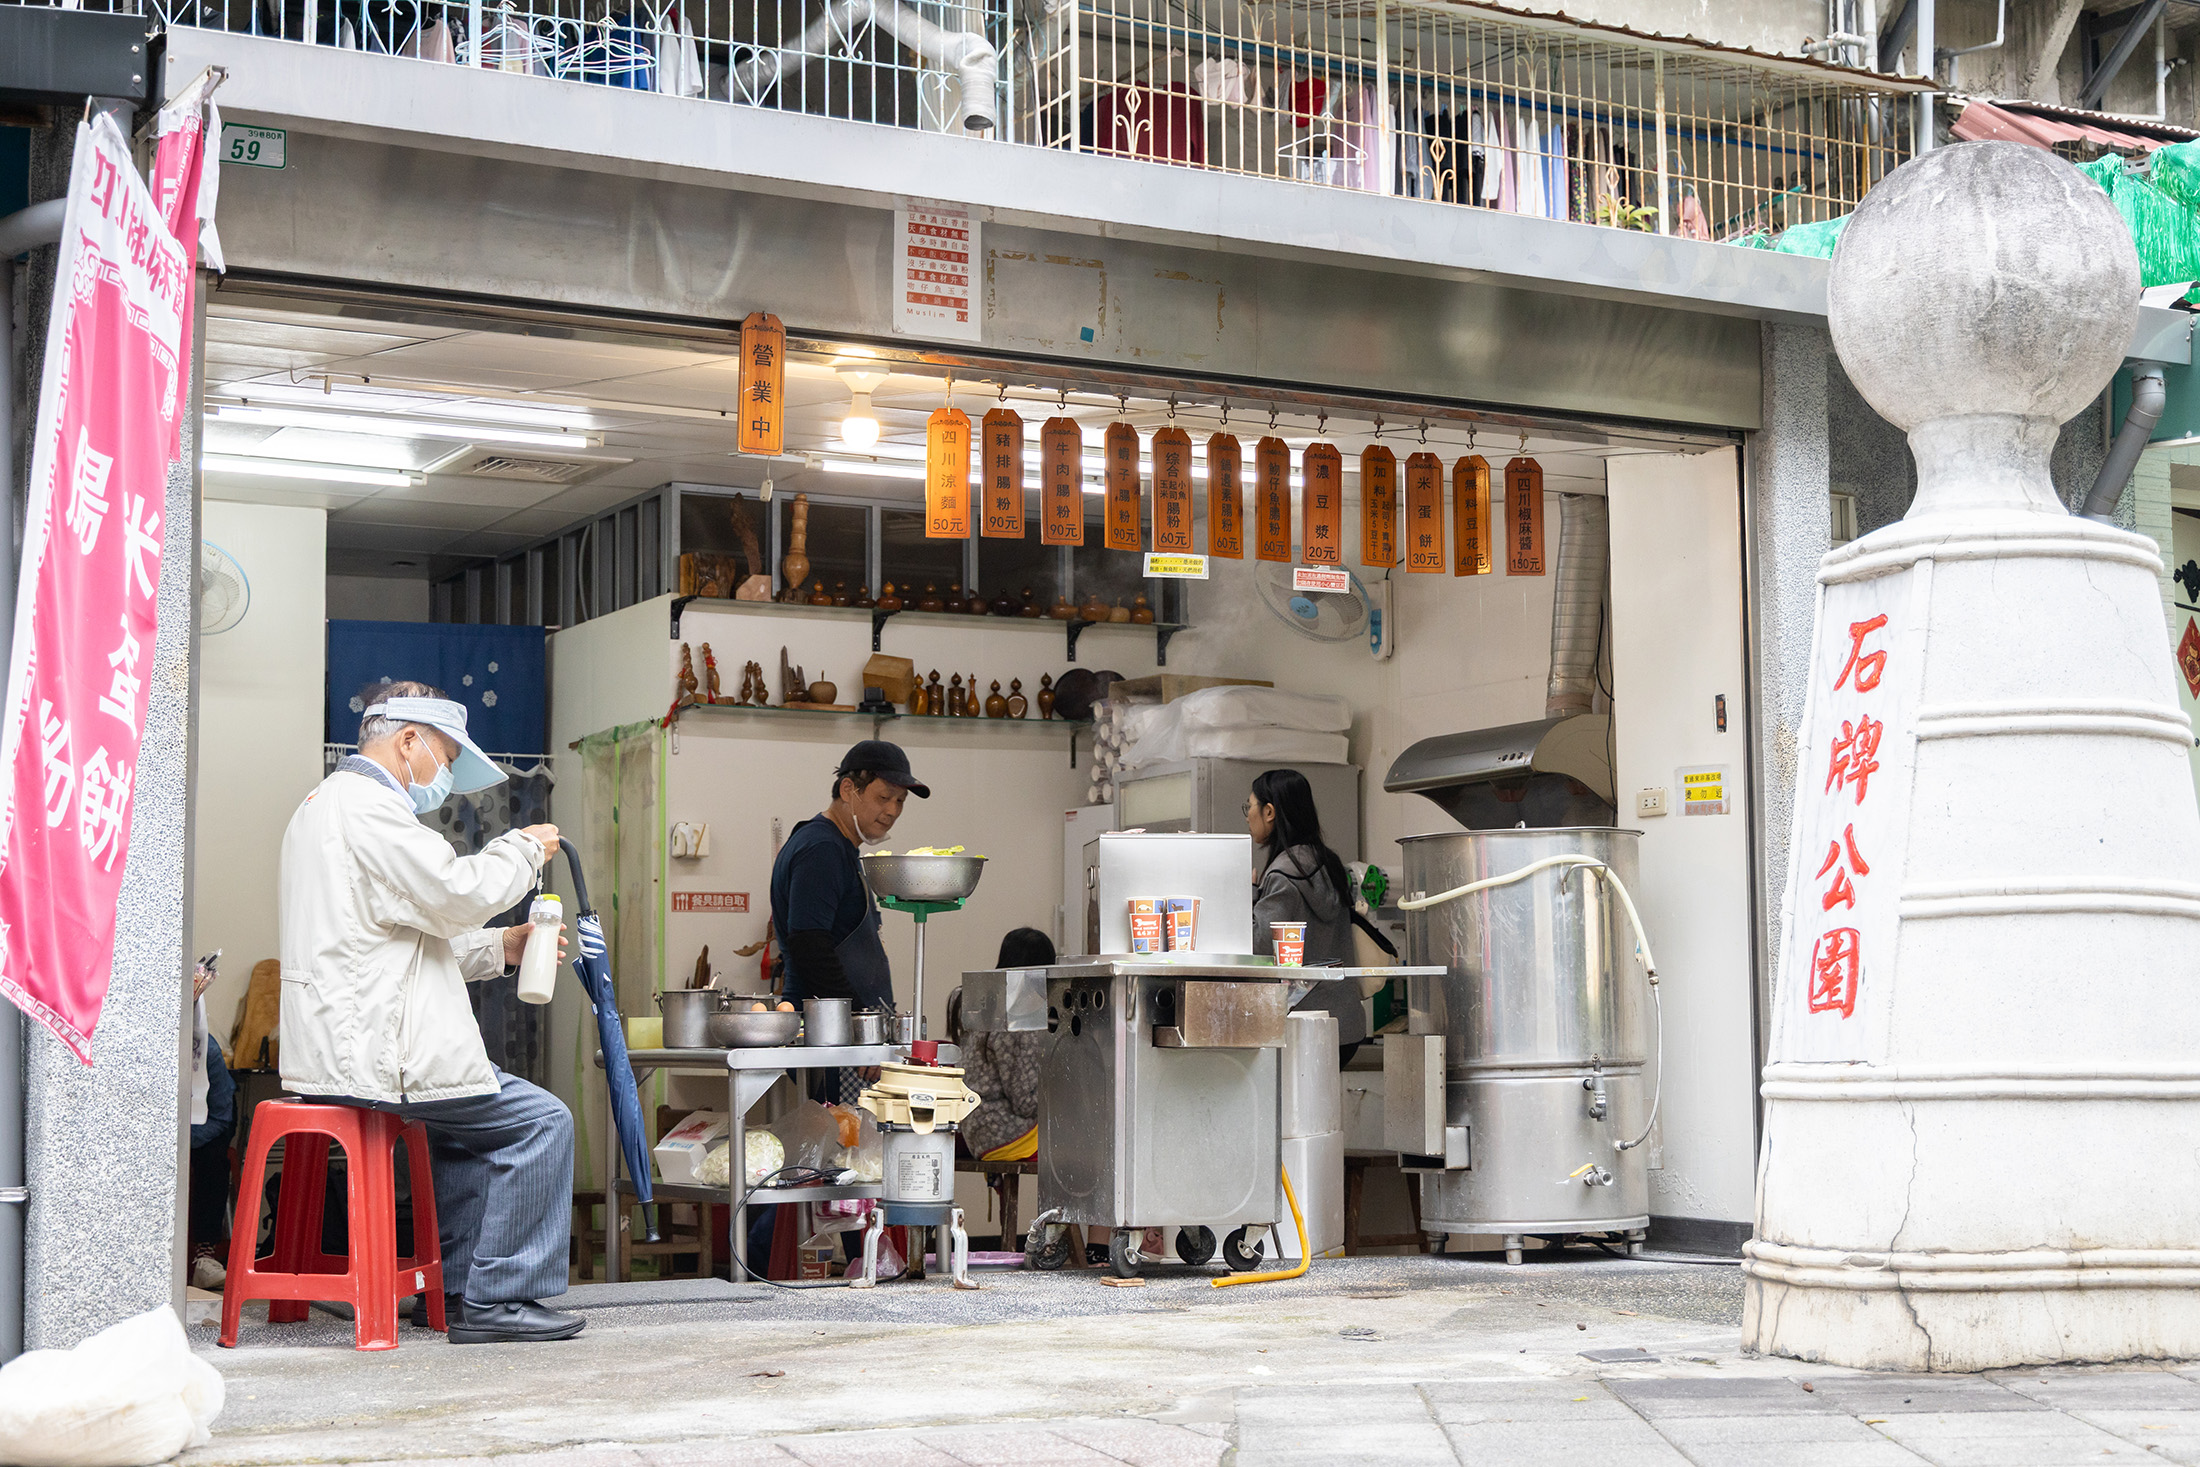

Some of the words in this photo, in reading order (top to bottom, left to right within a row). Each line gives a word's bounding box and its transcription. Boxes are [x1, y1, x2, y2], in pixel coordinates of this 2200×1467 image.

[248, 129, 283, 140] 39巷80弄
[231, 138, 261, 161] 59
[752, 343, 774, 439] 營業中
[941, 430, 957, 510] 四川涼麵
[996, 433, 1011, 511] 豬排腸粉
[1055, 442, 1071, 519] 牛肉腸粉
[1160, 479, 1169, 499] 玉米
[1169, 480, 1178, 501] 起司
[1178, 480, 1187, 501] 小魚
[1373, 465, 1387, 498] 加料
[1315, 464, 1330, 540] 濃豆漿
[1417, 475, 1432, 548] 米蛋餅
[933, 517, 964, 532] 50元
[989, 515, 1018, 530] 90元
[1167, 501, 1181, 529] 腸粉
[1464, 478, 1478, 550] 無料豆花
[1517, 478, 1532, 551] 四川椒麻醬
[1050, 523, 1078, 538] 90元
[1113, 528, 1136, 543] 90元
[1160, 532, 1187, 546] 60元
[1217, 536, 1239, 551] 60元
[1264, 540, 1286, 555] 60元
[1308, 546, 1336, 560] 20元
[1412, 552, 1439, 566] 30元
[1460, 553, 1485, 567] 40元
[79, 489, 161, 872] 米蛋餅
[1808, 613, 1889, 1020] 石牌公園
[692, 894, 745, 906] 餐具請自取
